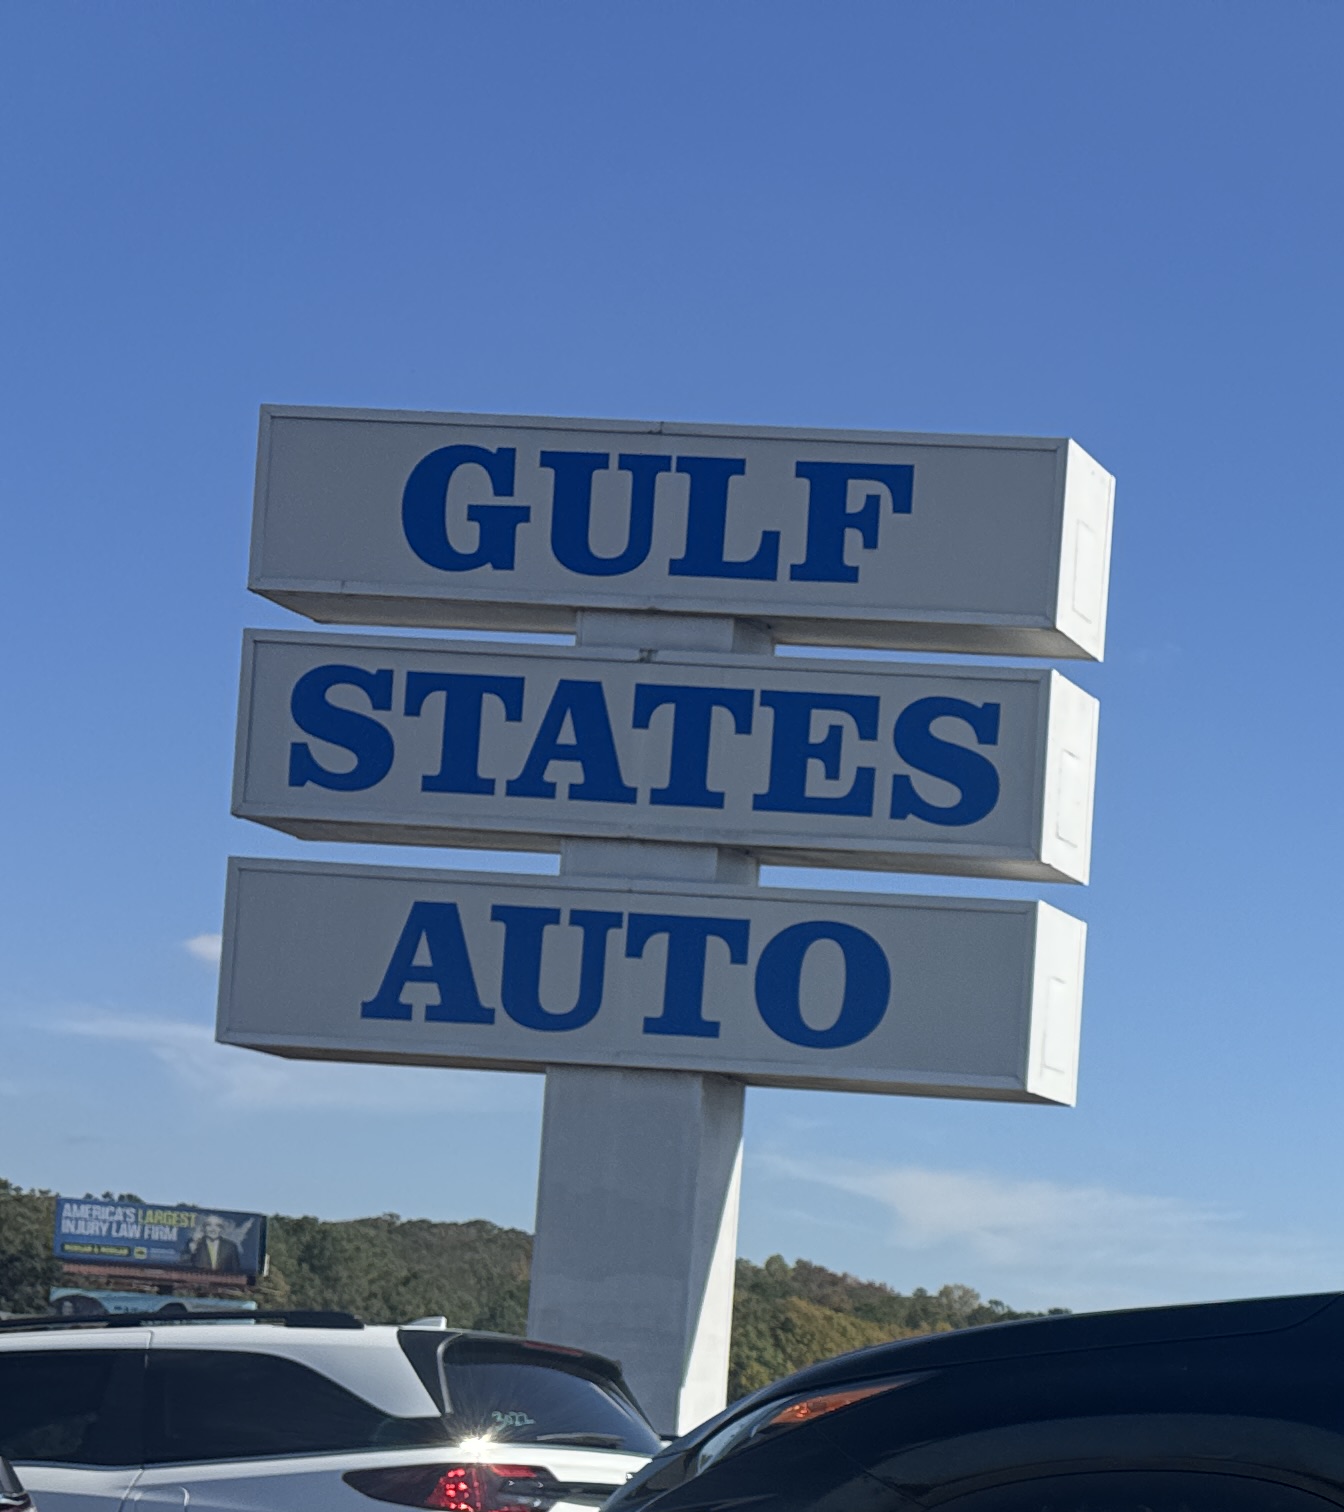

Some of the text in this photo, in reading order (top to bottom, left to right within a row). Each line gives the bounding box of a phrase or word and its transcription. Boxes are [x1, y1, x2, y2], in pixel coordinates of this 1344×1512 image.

[401, 444, 914, 583] GULF
[288, 663, 1001, 827] STATES
[360, 900, 892, 1049] AUTO
[61, 1219, 178, 1242] INJURY LAW FIRM
[62, 1203, 197, 1228] AMERICA'S LARGEST
